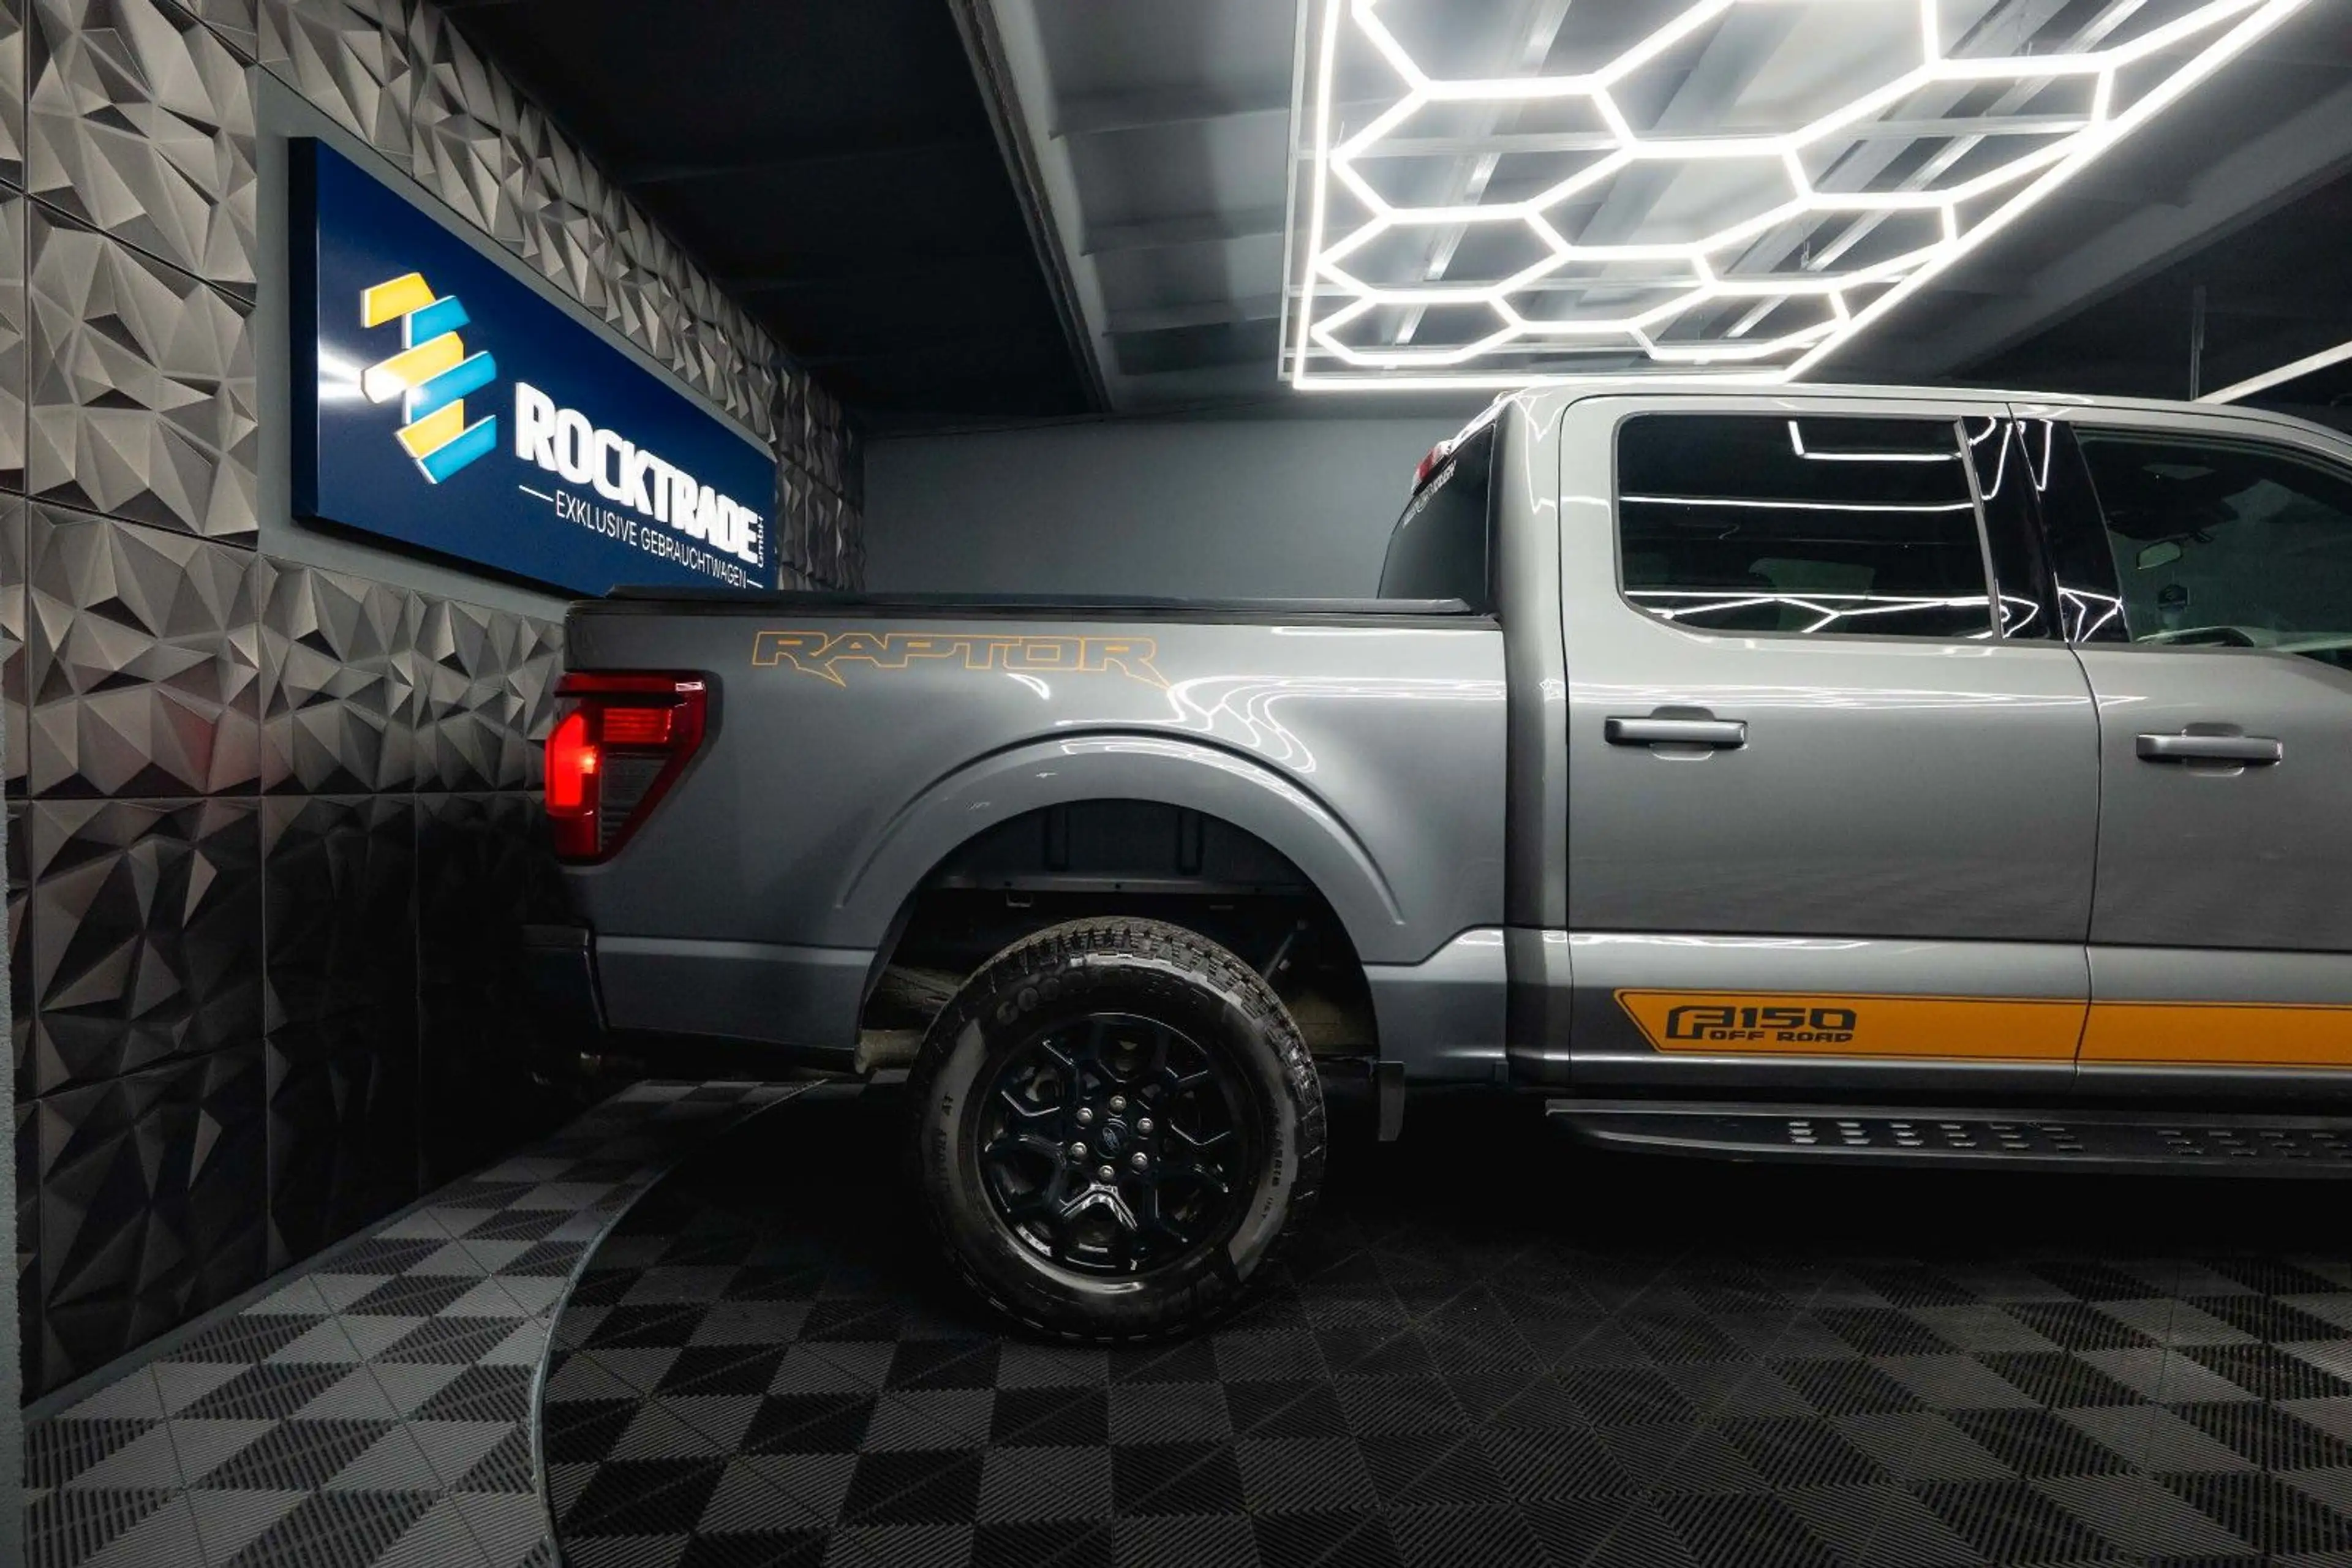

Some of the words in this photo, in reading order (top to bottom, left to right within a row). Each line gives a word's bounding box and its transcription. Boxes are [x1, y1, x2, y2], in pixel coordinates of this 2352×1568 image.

[515, 382, 758, 564] ROCKTRADE
[556, 489, 638, 546] EXKLUSIVE
[641, 527, 747, 589] GEBRAUCHTWAGEN
[752, 631, 1170, 690] RAPTOR
[1709, 1030, 1765, 1041] OFF
[1776, 1031, 1853, 1042] ROAD
